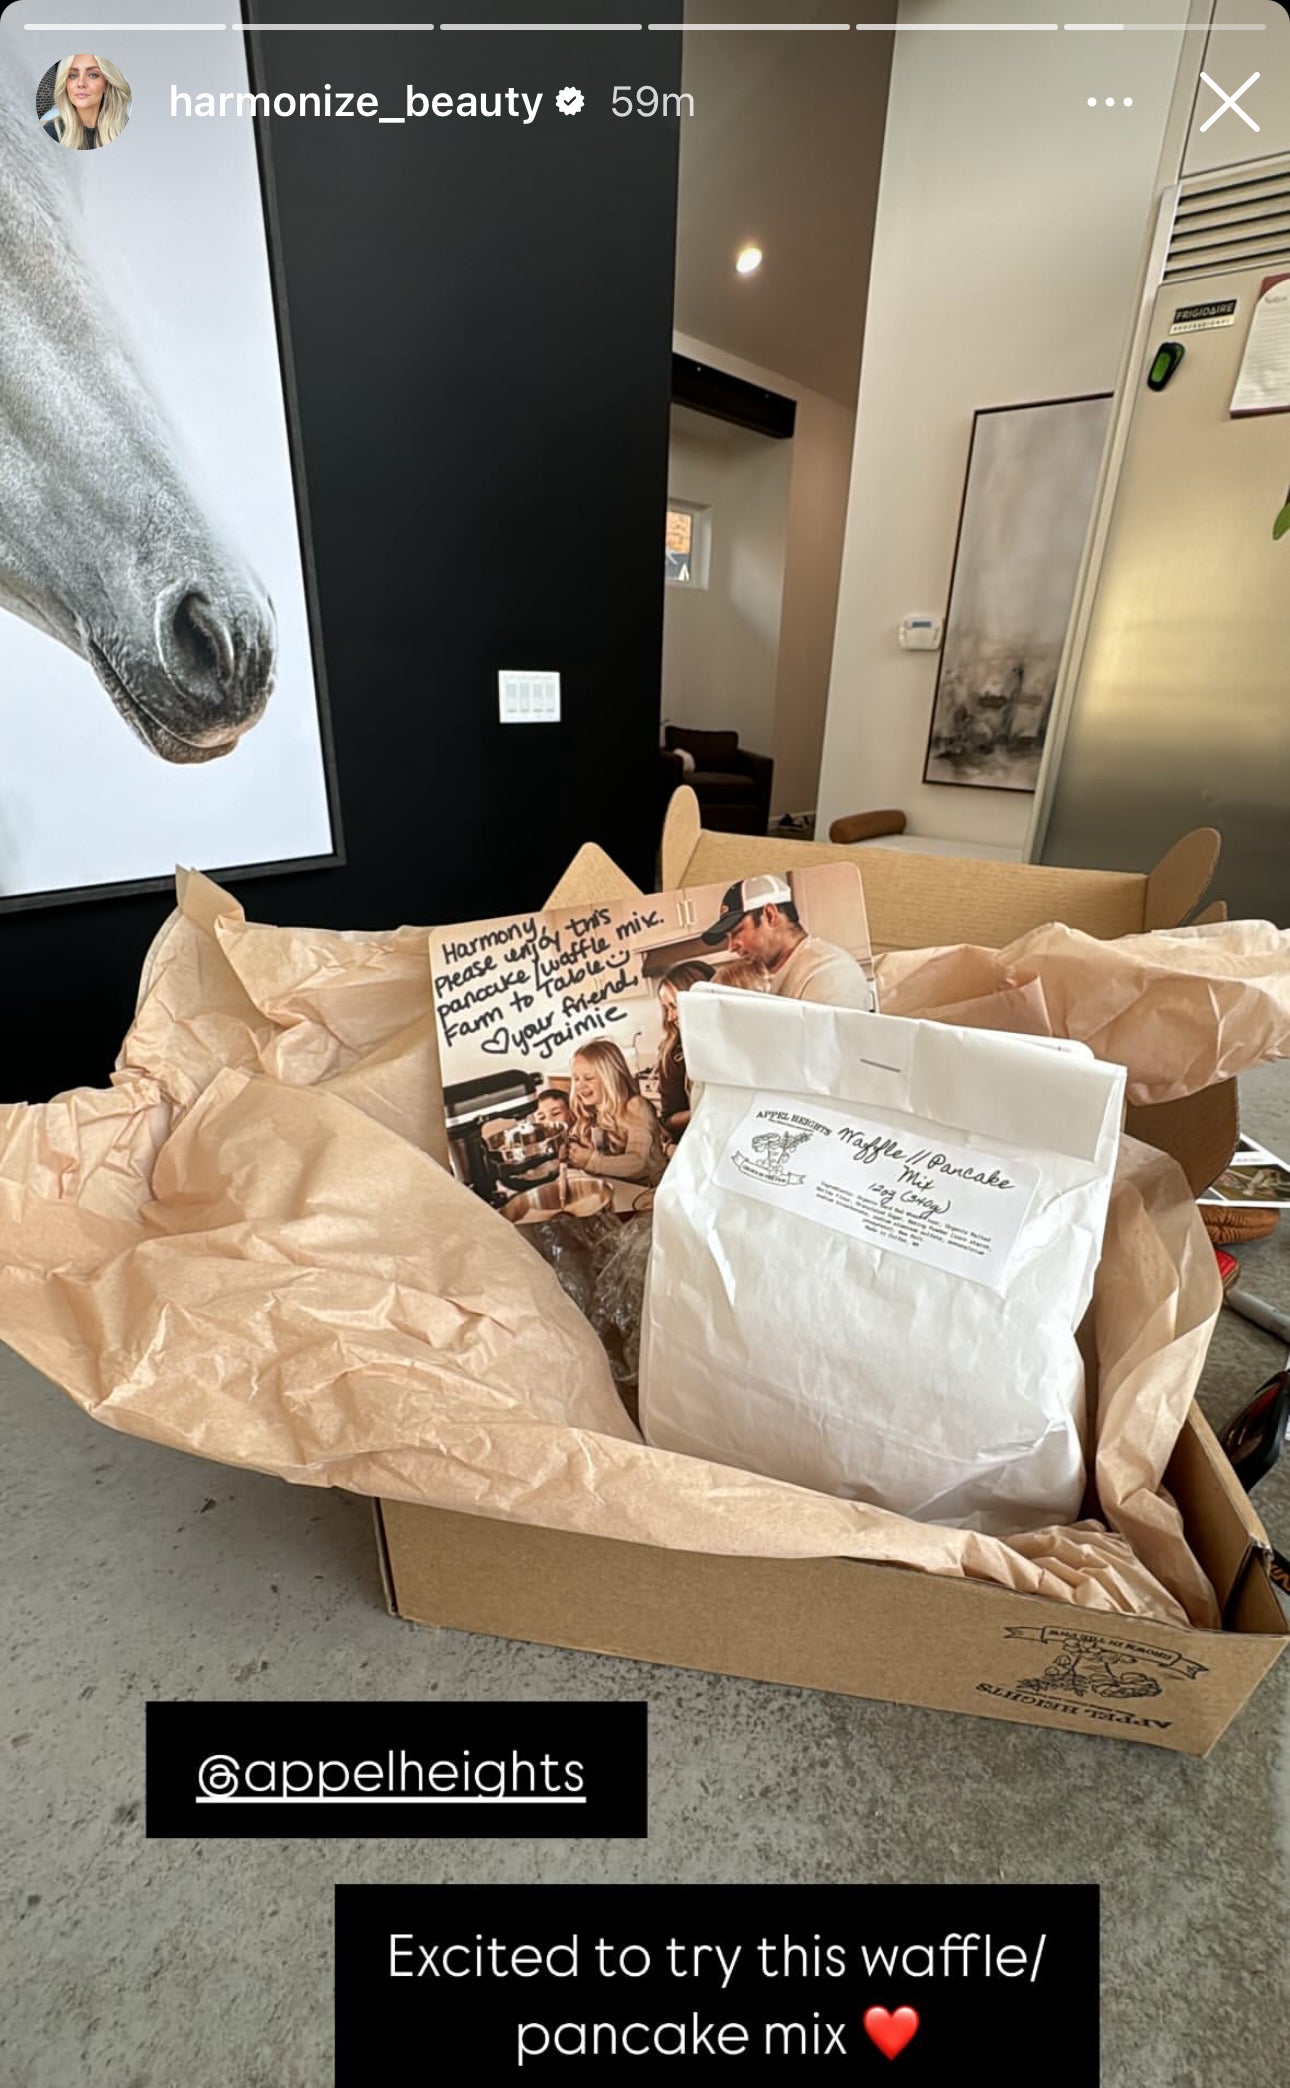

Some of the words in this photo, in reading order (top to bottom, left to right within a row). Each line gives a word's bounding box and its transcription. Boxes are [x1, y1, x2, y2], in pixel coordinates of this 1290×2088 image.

[1176, 302, 1235, 320] FRIGIDAIRE
[504, 926, 561, 963] enjoy
[565, 908, 612, 937] this
[510, 991, 534, 1013] to
[511, 1011, 555, 1056] your
[756, 1110, 790, 1121] APPEL
[791, 1114, 832, 1136] HEIGHTS
[837, 1127, 908, 1164] Waffle
[927, 1153, 1016, 1190] Pancake
[897, 1165, 935, 1191] Mix
[975, 1682, 1080, 1716] HEIGHTS
[1085, 1709, 1174, 1730] APPEL
